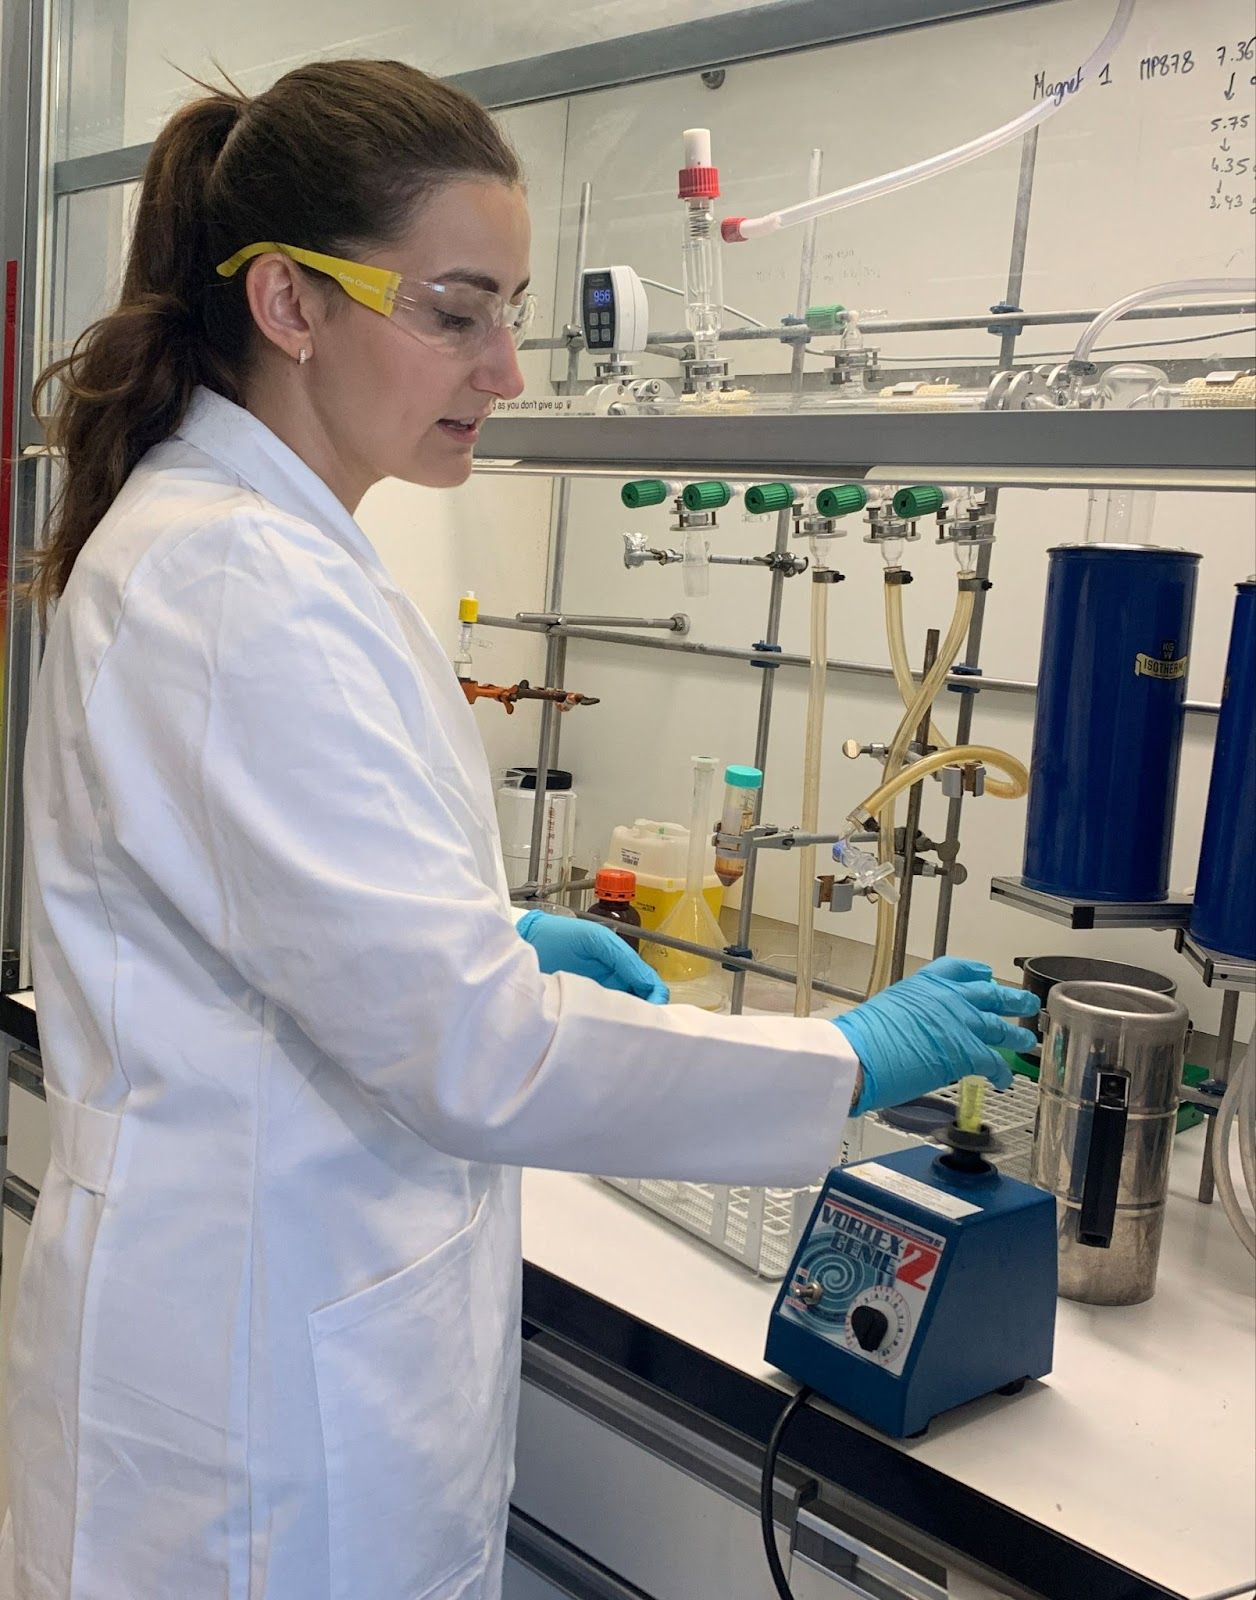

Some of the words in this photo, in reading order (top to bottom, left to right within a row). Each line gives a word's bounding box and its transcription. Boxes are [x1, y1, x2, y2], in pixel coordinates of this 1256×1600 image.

[1033, 66, 1084, 107] Magnet
[1099, 62, 1112, 86] 1
[1140, 50, 1194, 81] MP878
[1210, 114, 1250, 132] 5.75
[1211, 157, 1250, 176] 4.35
[593, 289, 611, 302] 956
[497, 401, 506, 410] as
[507, 401, 520, 411] you
[520, 400, 538, 410] don't
[538, 401, 553, 411] give
[554, 401, 564, 411] up
[896, 1243, 938, 1291] 2
